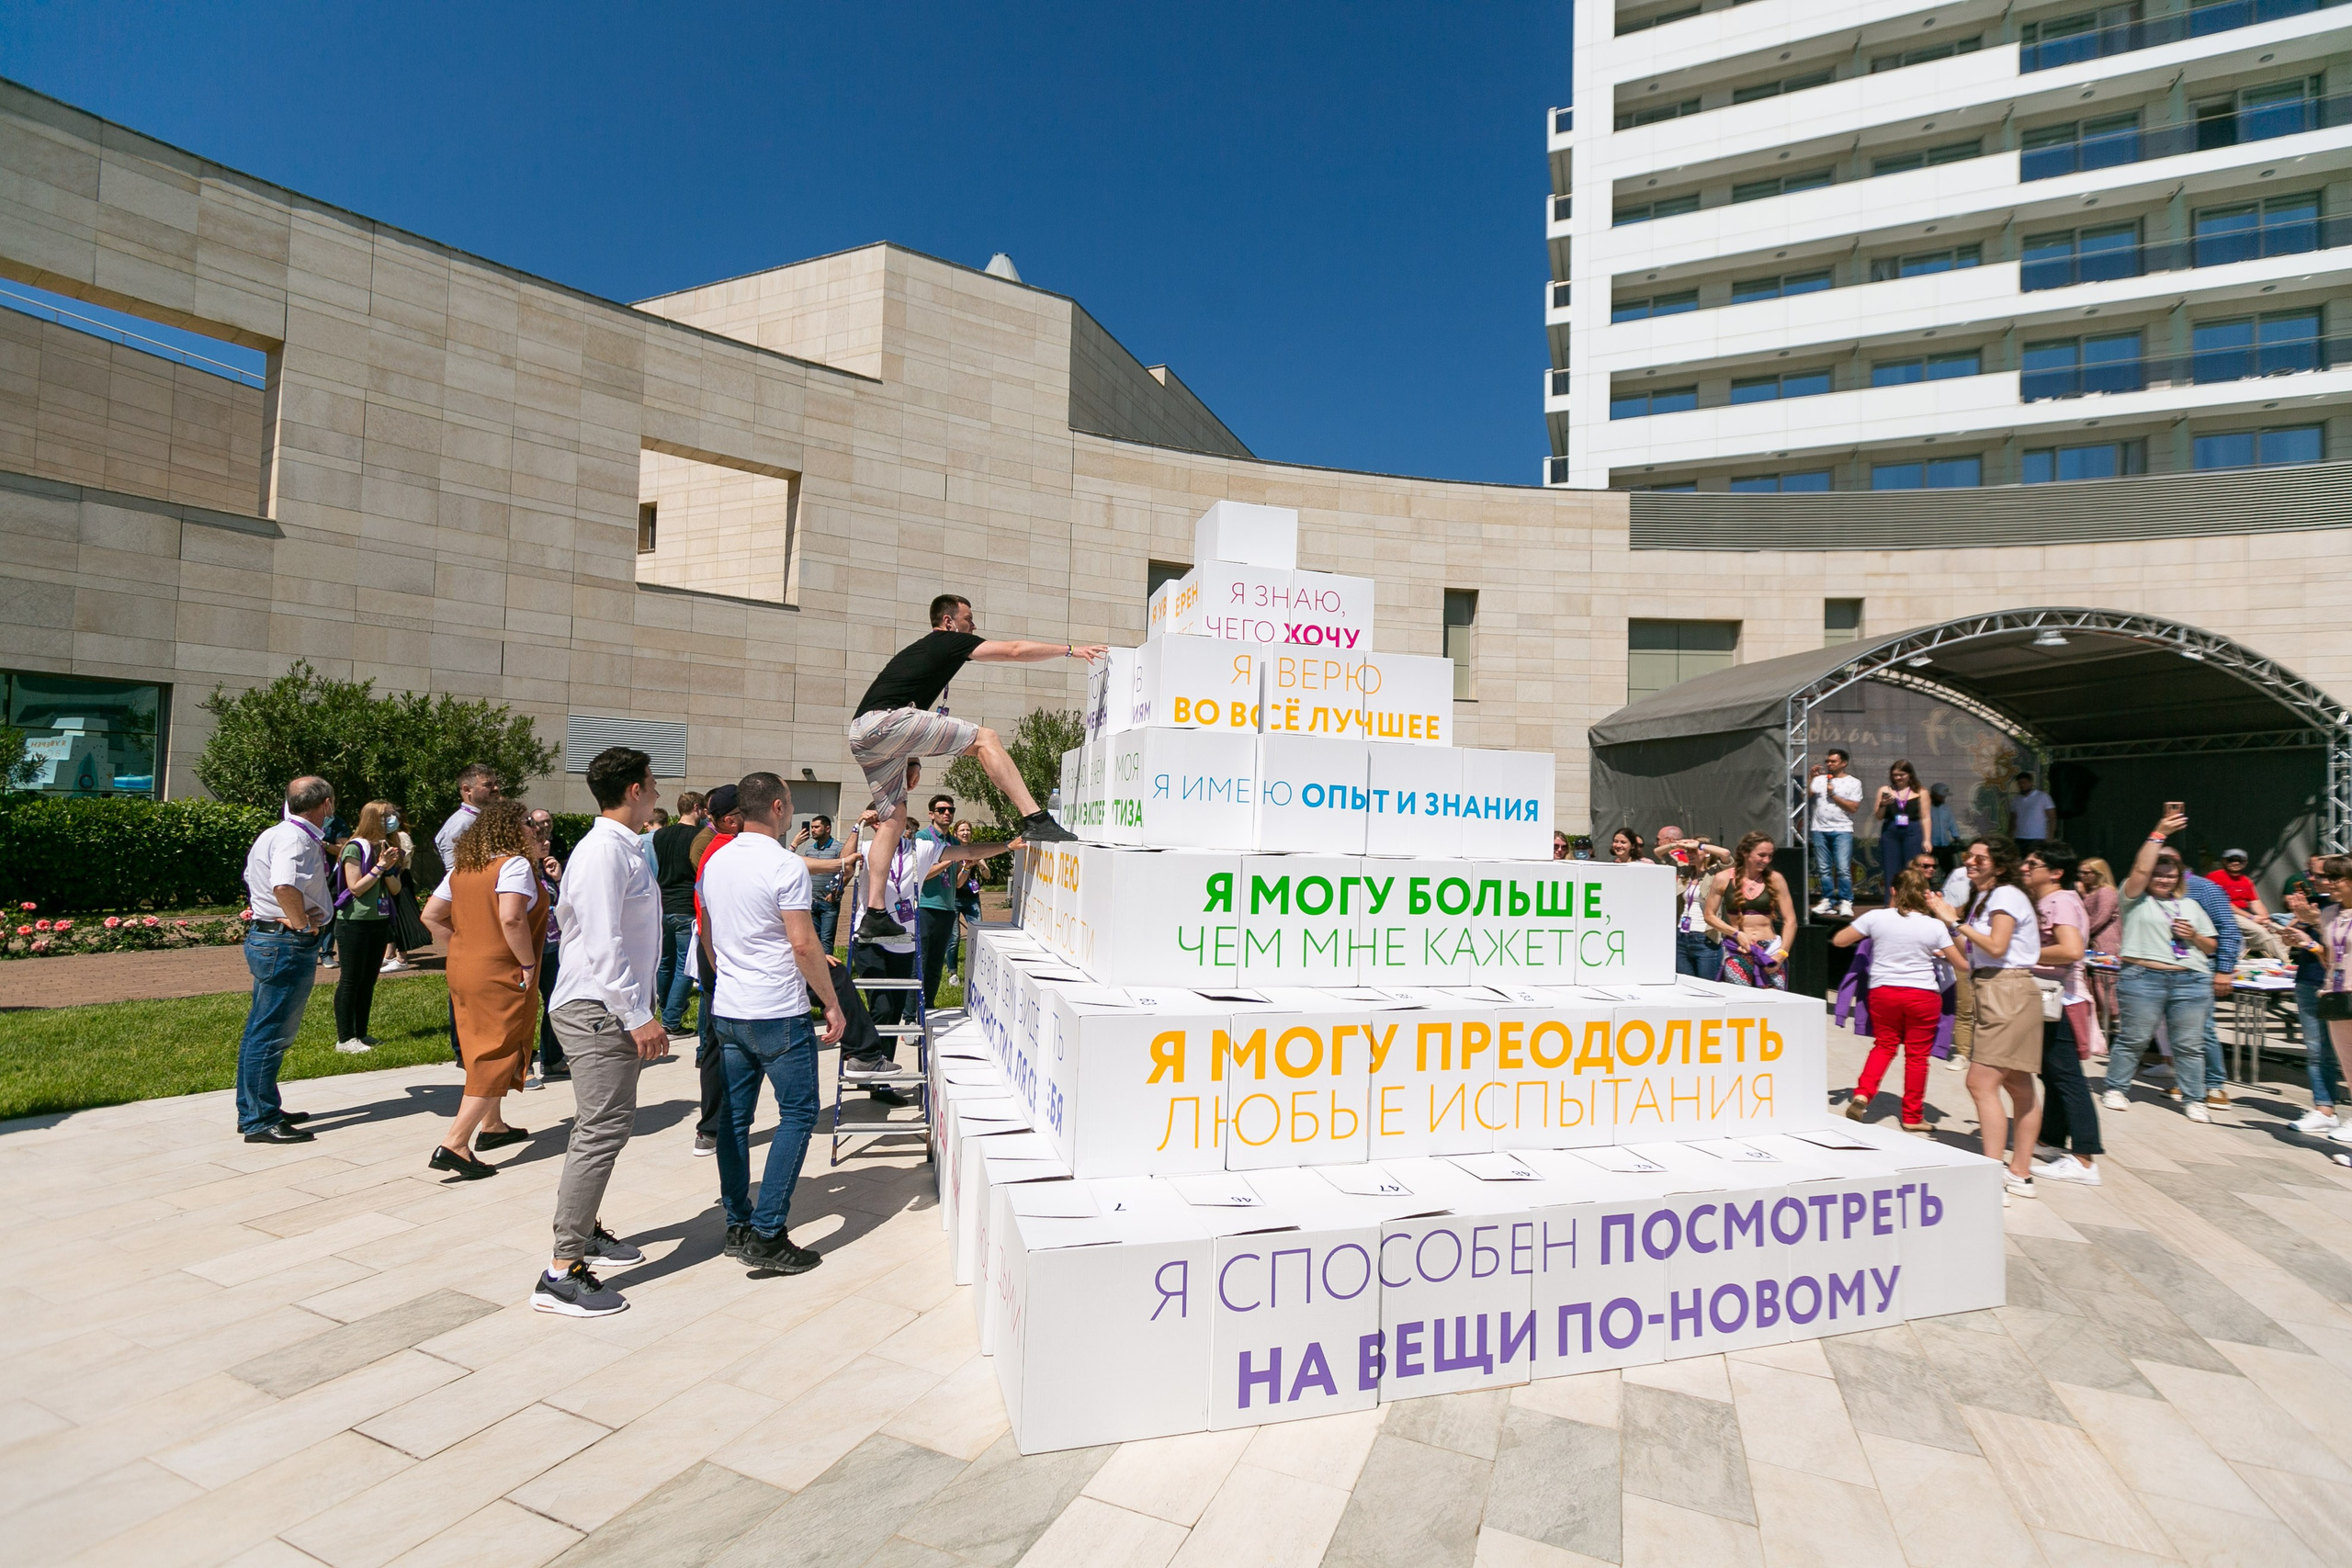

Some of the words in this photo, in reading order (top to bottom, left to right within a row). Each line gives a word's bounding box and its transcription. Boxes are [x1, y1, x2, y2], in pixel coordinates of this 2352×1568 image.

[1231, 581, 1245, 604] Я
[1254, 585, 1347, 617] ЗНАЮ,
[1206, 615, 1275, 643] ЧЕГО
[1283, 622, 1361, 649] ХОЧУ
[1231, 654, 1252, 685] Я
[1278, 656, 1383, 695] ВЕРЮ
[1174, 695, 1221, 726] ВО
[1229, 696, 1301, 732] ВСЁ
[1307, 705, 1441, 740] ЛУЧШЕЕ
[1114, 752, 1139, 782] МОЯ
[1153, 773, 1170, 799] Я
[1182, 775, 1293, 807] ИМЕЮ
[1301, 782, 1389, 815] ОПЫТ
[1397, 790, 1417, 815] И
[1424, 791, 1539, 823] ЗНАНИЯ
[1203, 872, 1234, 913] Я
[1250, 874, 1396, 916] МОГУ
[1408, 876, 1612, 925] БОЛЬШЕ,
[1178, 925, 1282, 968] ЧЕМ
[1303, 927, 1408, 968] МНЕ
[1424, 928, 1625, 967] КАЖЕТСЯ
[1146, 1030, 1187, 1085] Я
[1210, 1022, 1400, 1083] МОГУ
[1415, 1017, 1785, 1075] ПРЕОДОЛЕТЬ
[1156, 1084, 1407, 1152] ЛЮБЫЕ
[1429, 1073, 1775, 1134] ИСПЫТАНИЯ
[1150, 1259, 1189, 1321] Я
[1218, 1218, 1577, 1313] СПОСОБЕН
[1600, 1182, 1945, 1266] ПОСМОТРЕТЬ
[1238, 1341, 1339, 1409] НА
[1358, 1309, 1536, 1393] ВЕЩИ
[1558, 1264, 1903, 1358] ПО-НОВОМУ
